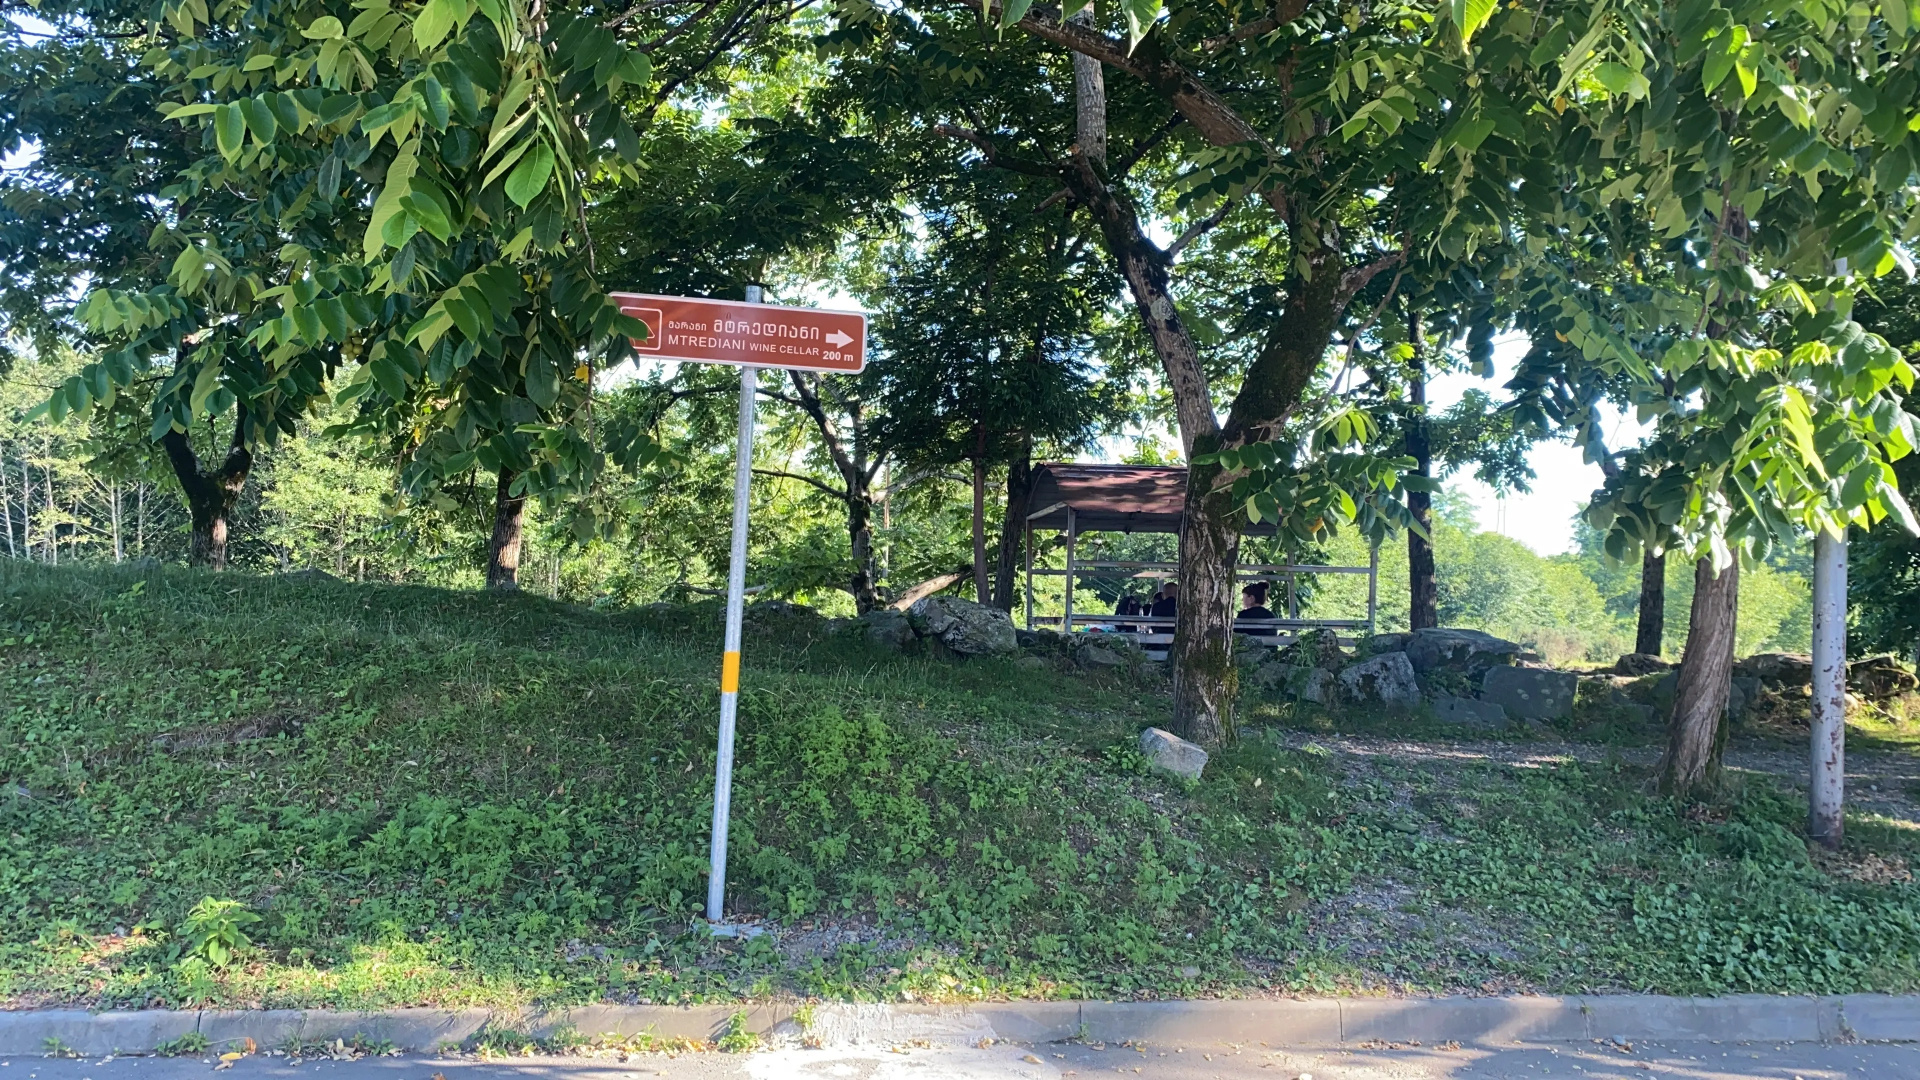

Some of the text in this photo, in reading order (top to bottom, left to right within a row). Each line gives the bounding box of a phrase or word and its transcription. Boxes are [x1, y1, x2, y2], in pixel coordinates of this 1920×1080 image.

[668, 319, 819, 340] მარანი მტრედიანი
[668, 334, 819, 356] MTREDIANI WINE CELLAR
[822, 350, 854, 362] 200 m
